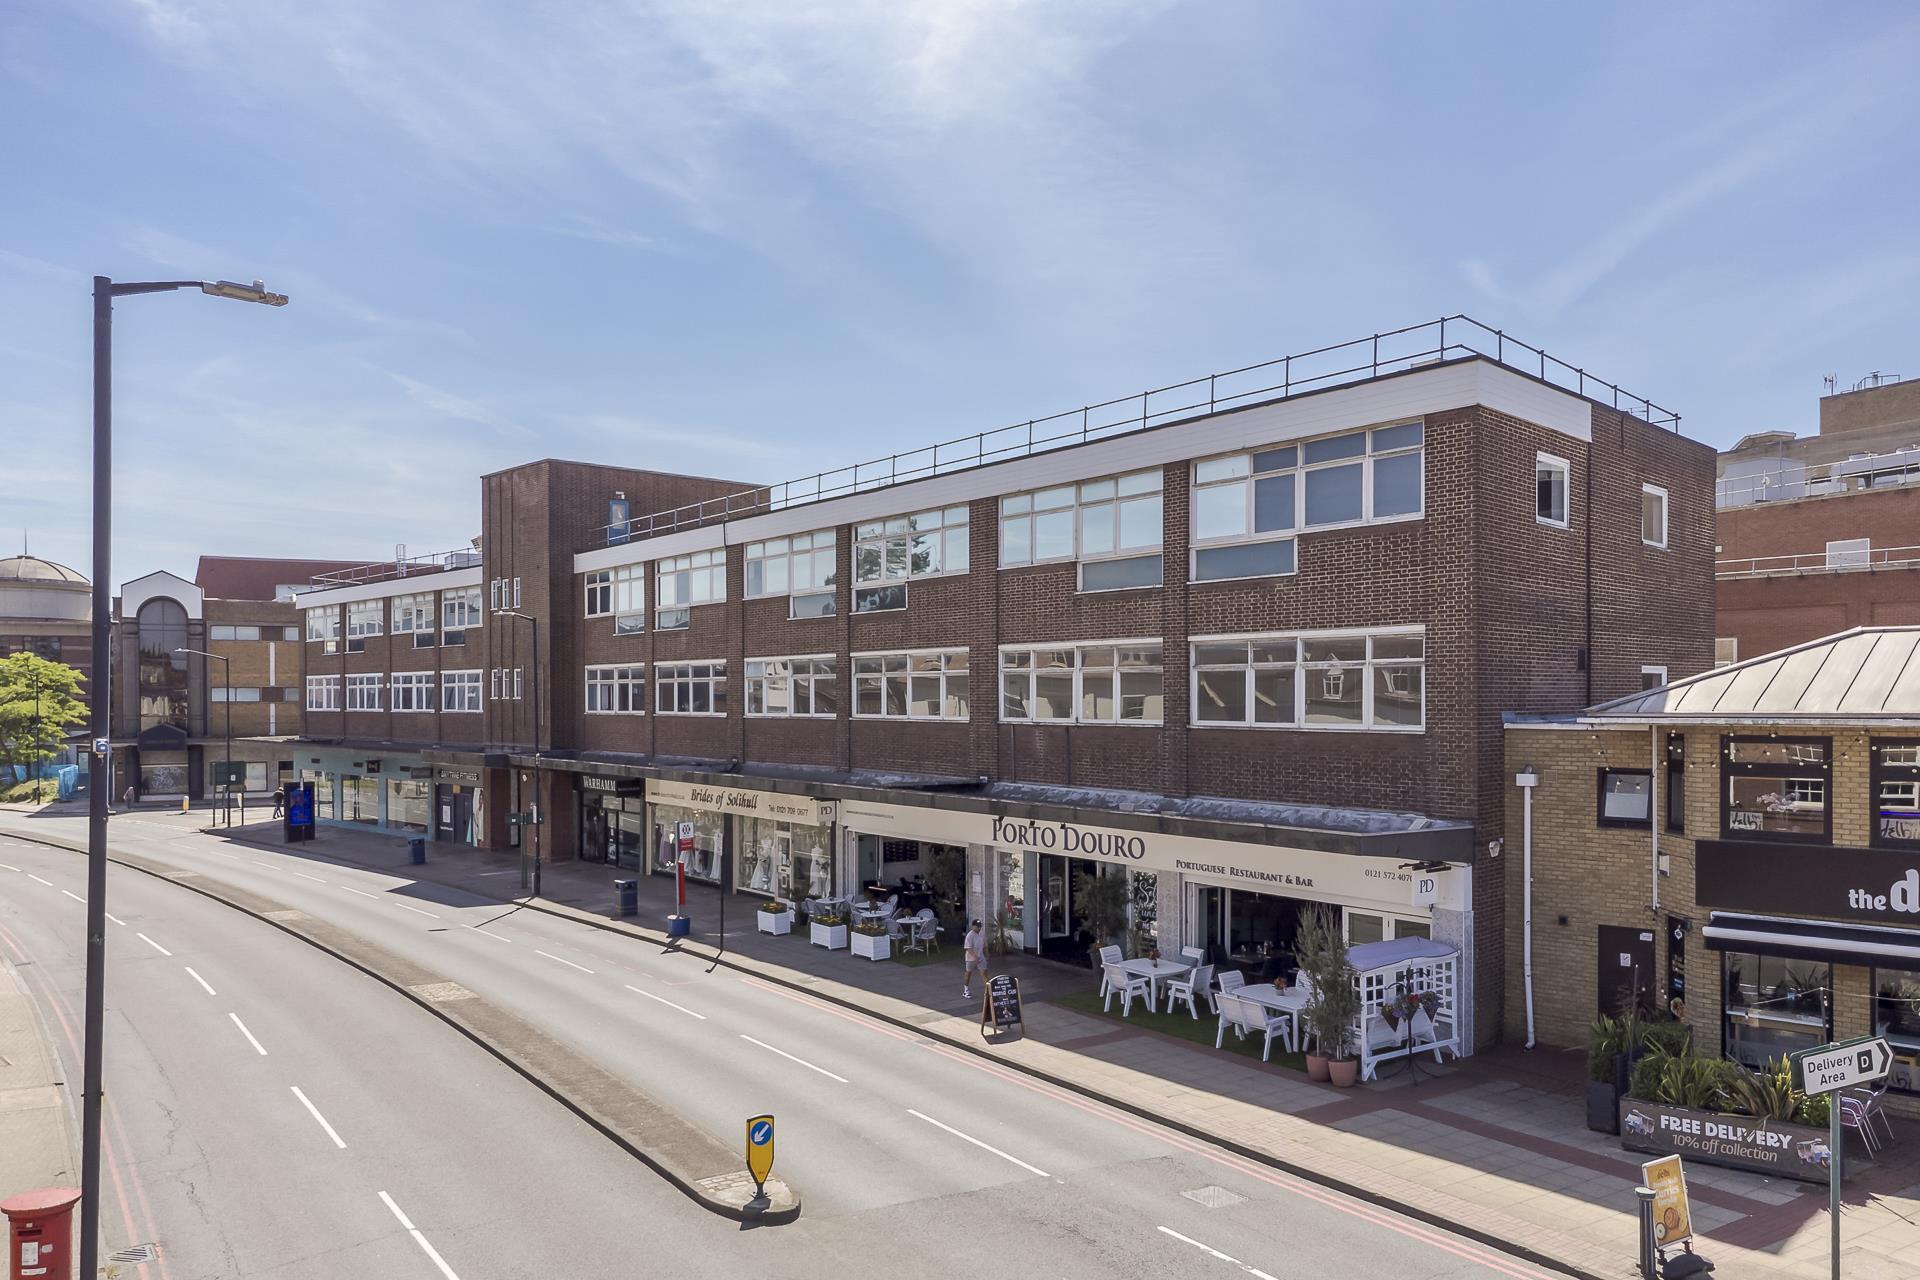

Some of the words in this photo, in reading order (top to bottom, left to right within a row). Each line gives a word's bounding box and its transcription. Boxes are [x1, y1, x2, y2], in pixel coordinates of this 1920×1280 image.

[582, 775, 616, 791] WARHAMM
[690, 788, 713, 803] Brides
[715, 790, 726, 810] of
[726, 792, 759, 810] Solihull
[820, 806, 832, 816] PD
[992, 818, 1056, 848] PORTO
[1062, 826, 1146, 860] DOURO
[1175, 859, 1226, 875] PORTUGUESE
[1229, 866, 1284, 883] RESTAURANT
[1285, 875, 1294, 885] &
[1295, 876, 1314, 887] BAR
[1364, 868, 1381, 878] 0121
[1383, 871, 1396, 880] 572
[1419, 878, 1435, 894] PD
[1848, 888, 1887, 911] the
[1807, 1055, 1854, 1073] Delivery
[1860, 1056, 1870, 1068] D
[1820, 1072, 1846, 1086] Area
[1660, 1115, 1701, 1135] FREE
[1705, 1122, 1793, 1149] DELIVERY
[1672, 1134, 1700, 1149] 10%
[1702, 1139, 1720, 1155] off
[1720, 1142, 1778, 1162] collection
